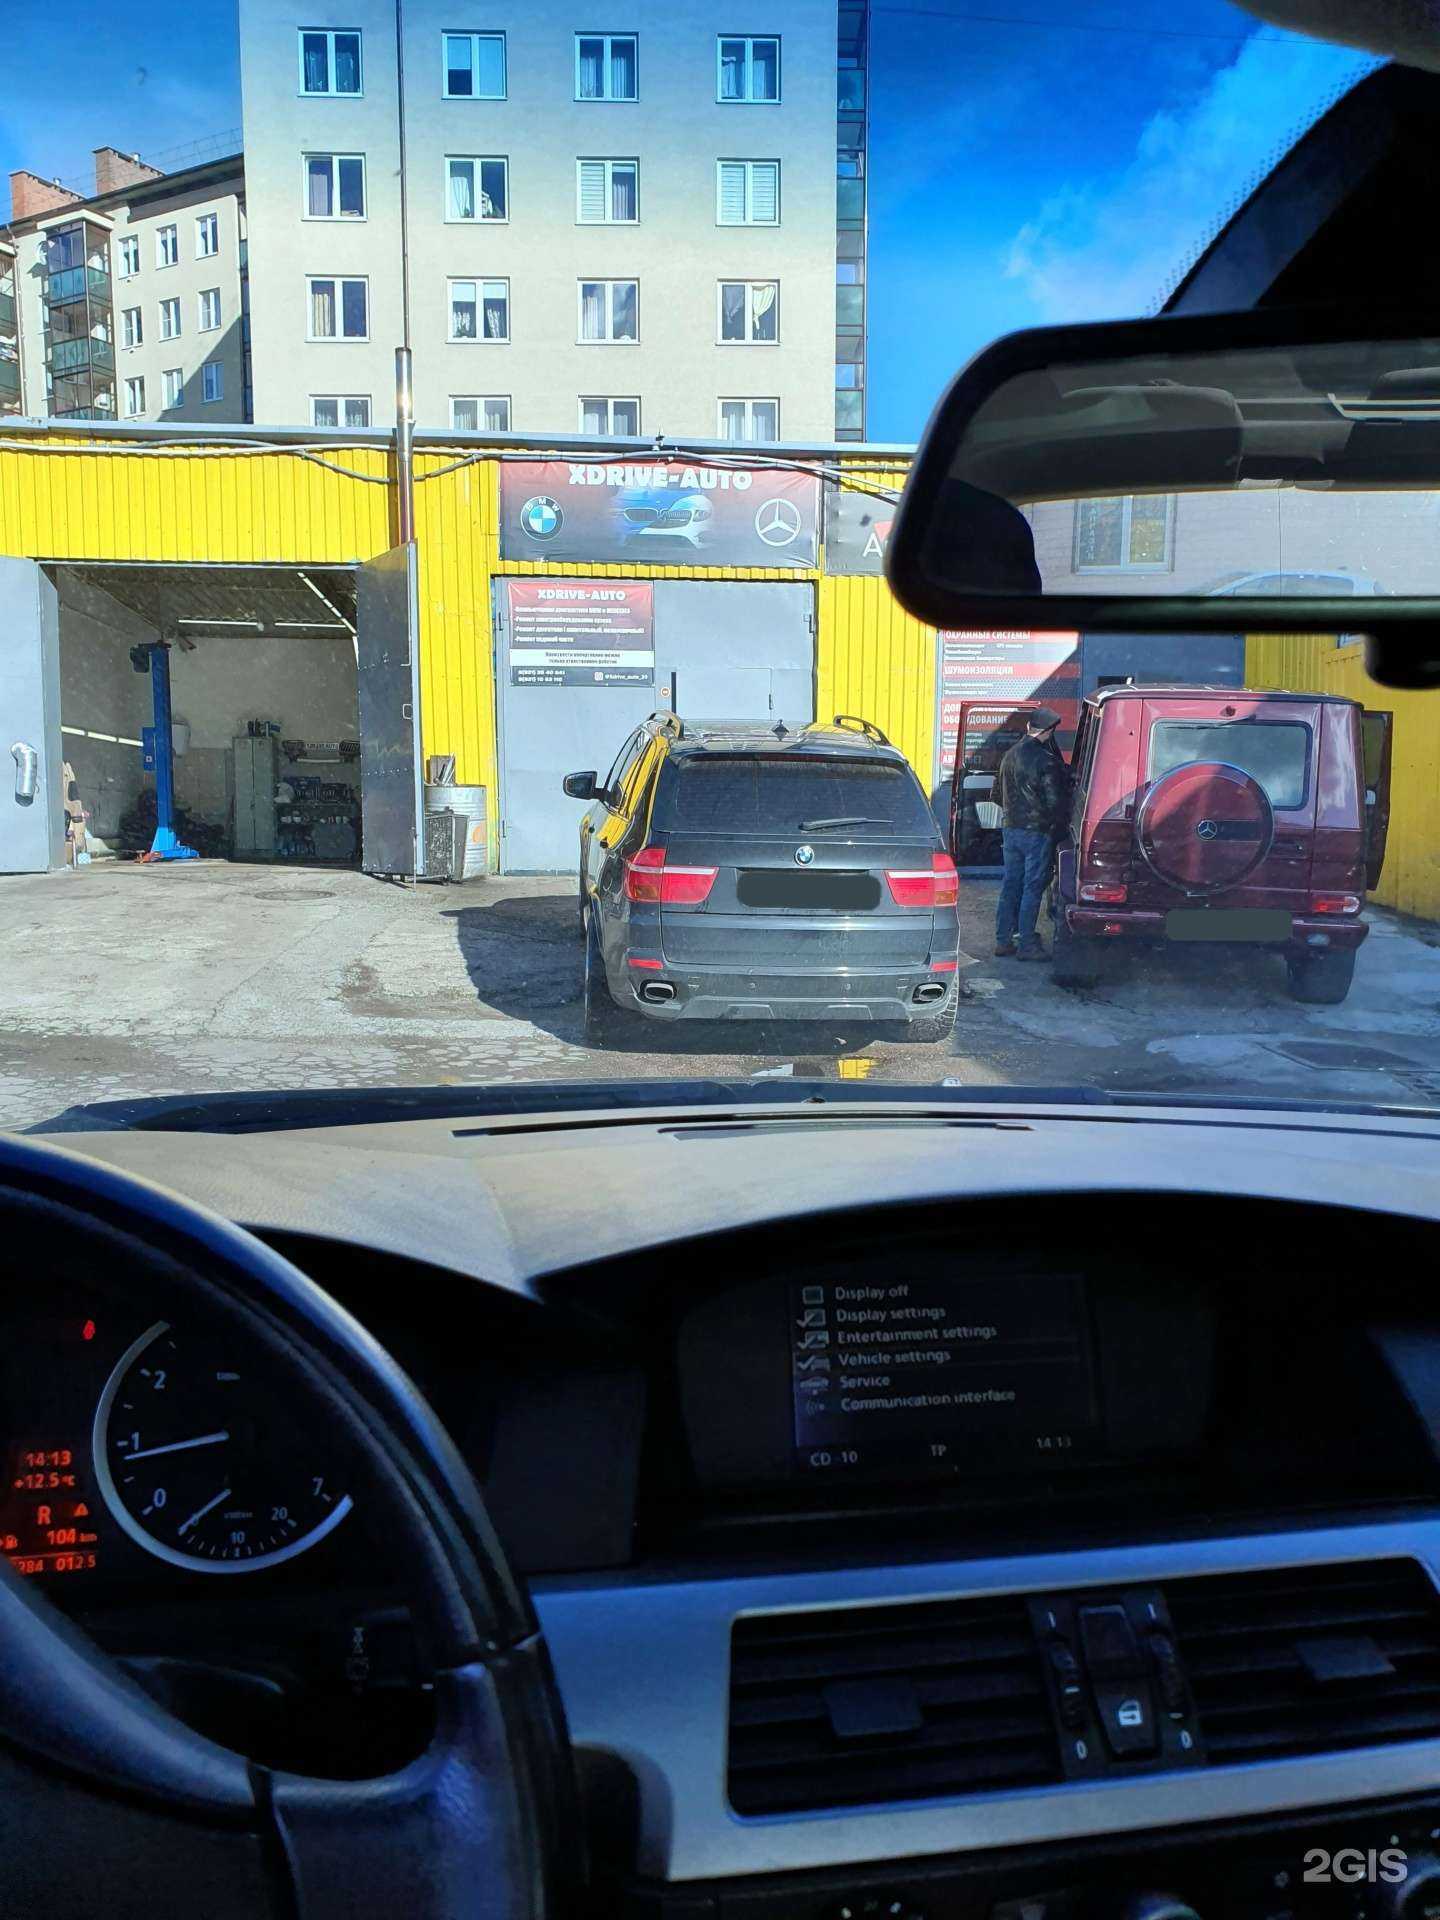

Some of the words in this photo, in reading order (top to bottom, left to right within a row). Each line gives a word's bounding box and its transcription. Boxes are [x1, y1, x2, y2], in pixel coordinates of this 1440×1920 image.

[568, 464, 752, 490] XDRIVE-AUTO
[537, 589, 626, 601] XDRIVE-AUTO
[944, 666, 1014, 676] ШУМОИЗОЛЯЦИЯ
[835, 1287, 885, 1302] Display
[888, 1285, 910, 1297] off
[837, 1309, 887, 1323] Display
[890, 1306, 946, 1320] settings
[838, 1328, 938, 1344] Entertainment
[942, 1325, 998, 1340] settings
[839, 1353, 891, 1367] Vehicle
[895, 1350, 951, 1364] settings
[154, 1370, 166, 1389] 2
[840, 1374, 891, 1389] Service
[841, 1394, 951, 1413] Communication
[955, 1390, 1016, 1404] interface
[810, 1451, 832, 1466] CD
[842, 1450, 858, 1464] 10
[153, 1488, 166, 1507] 0
[37, 1505, 51, 1525] R
[271, 1506, 288, 1521] 20
[47, 1529, 76, 1545] 104
[231, 1531, 245, 1545] 10
